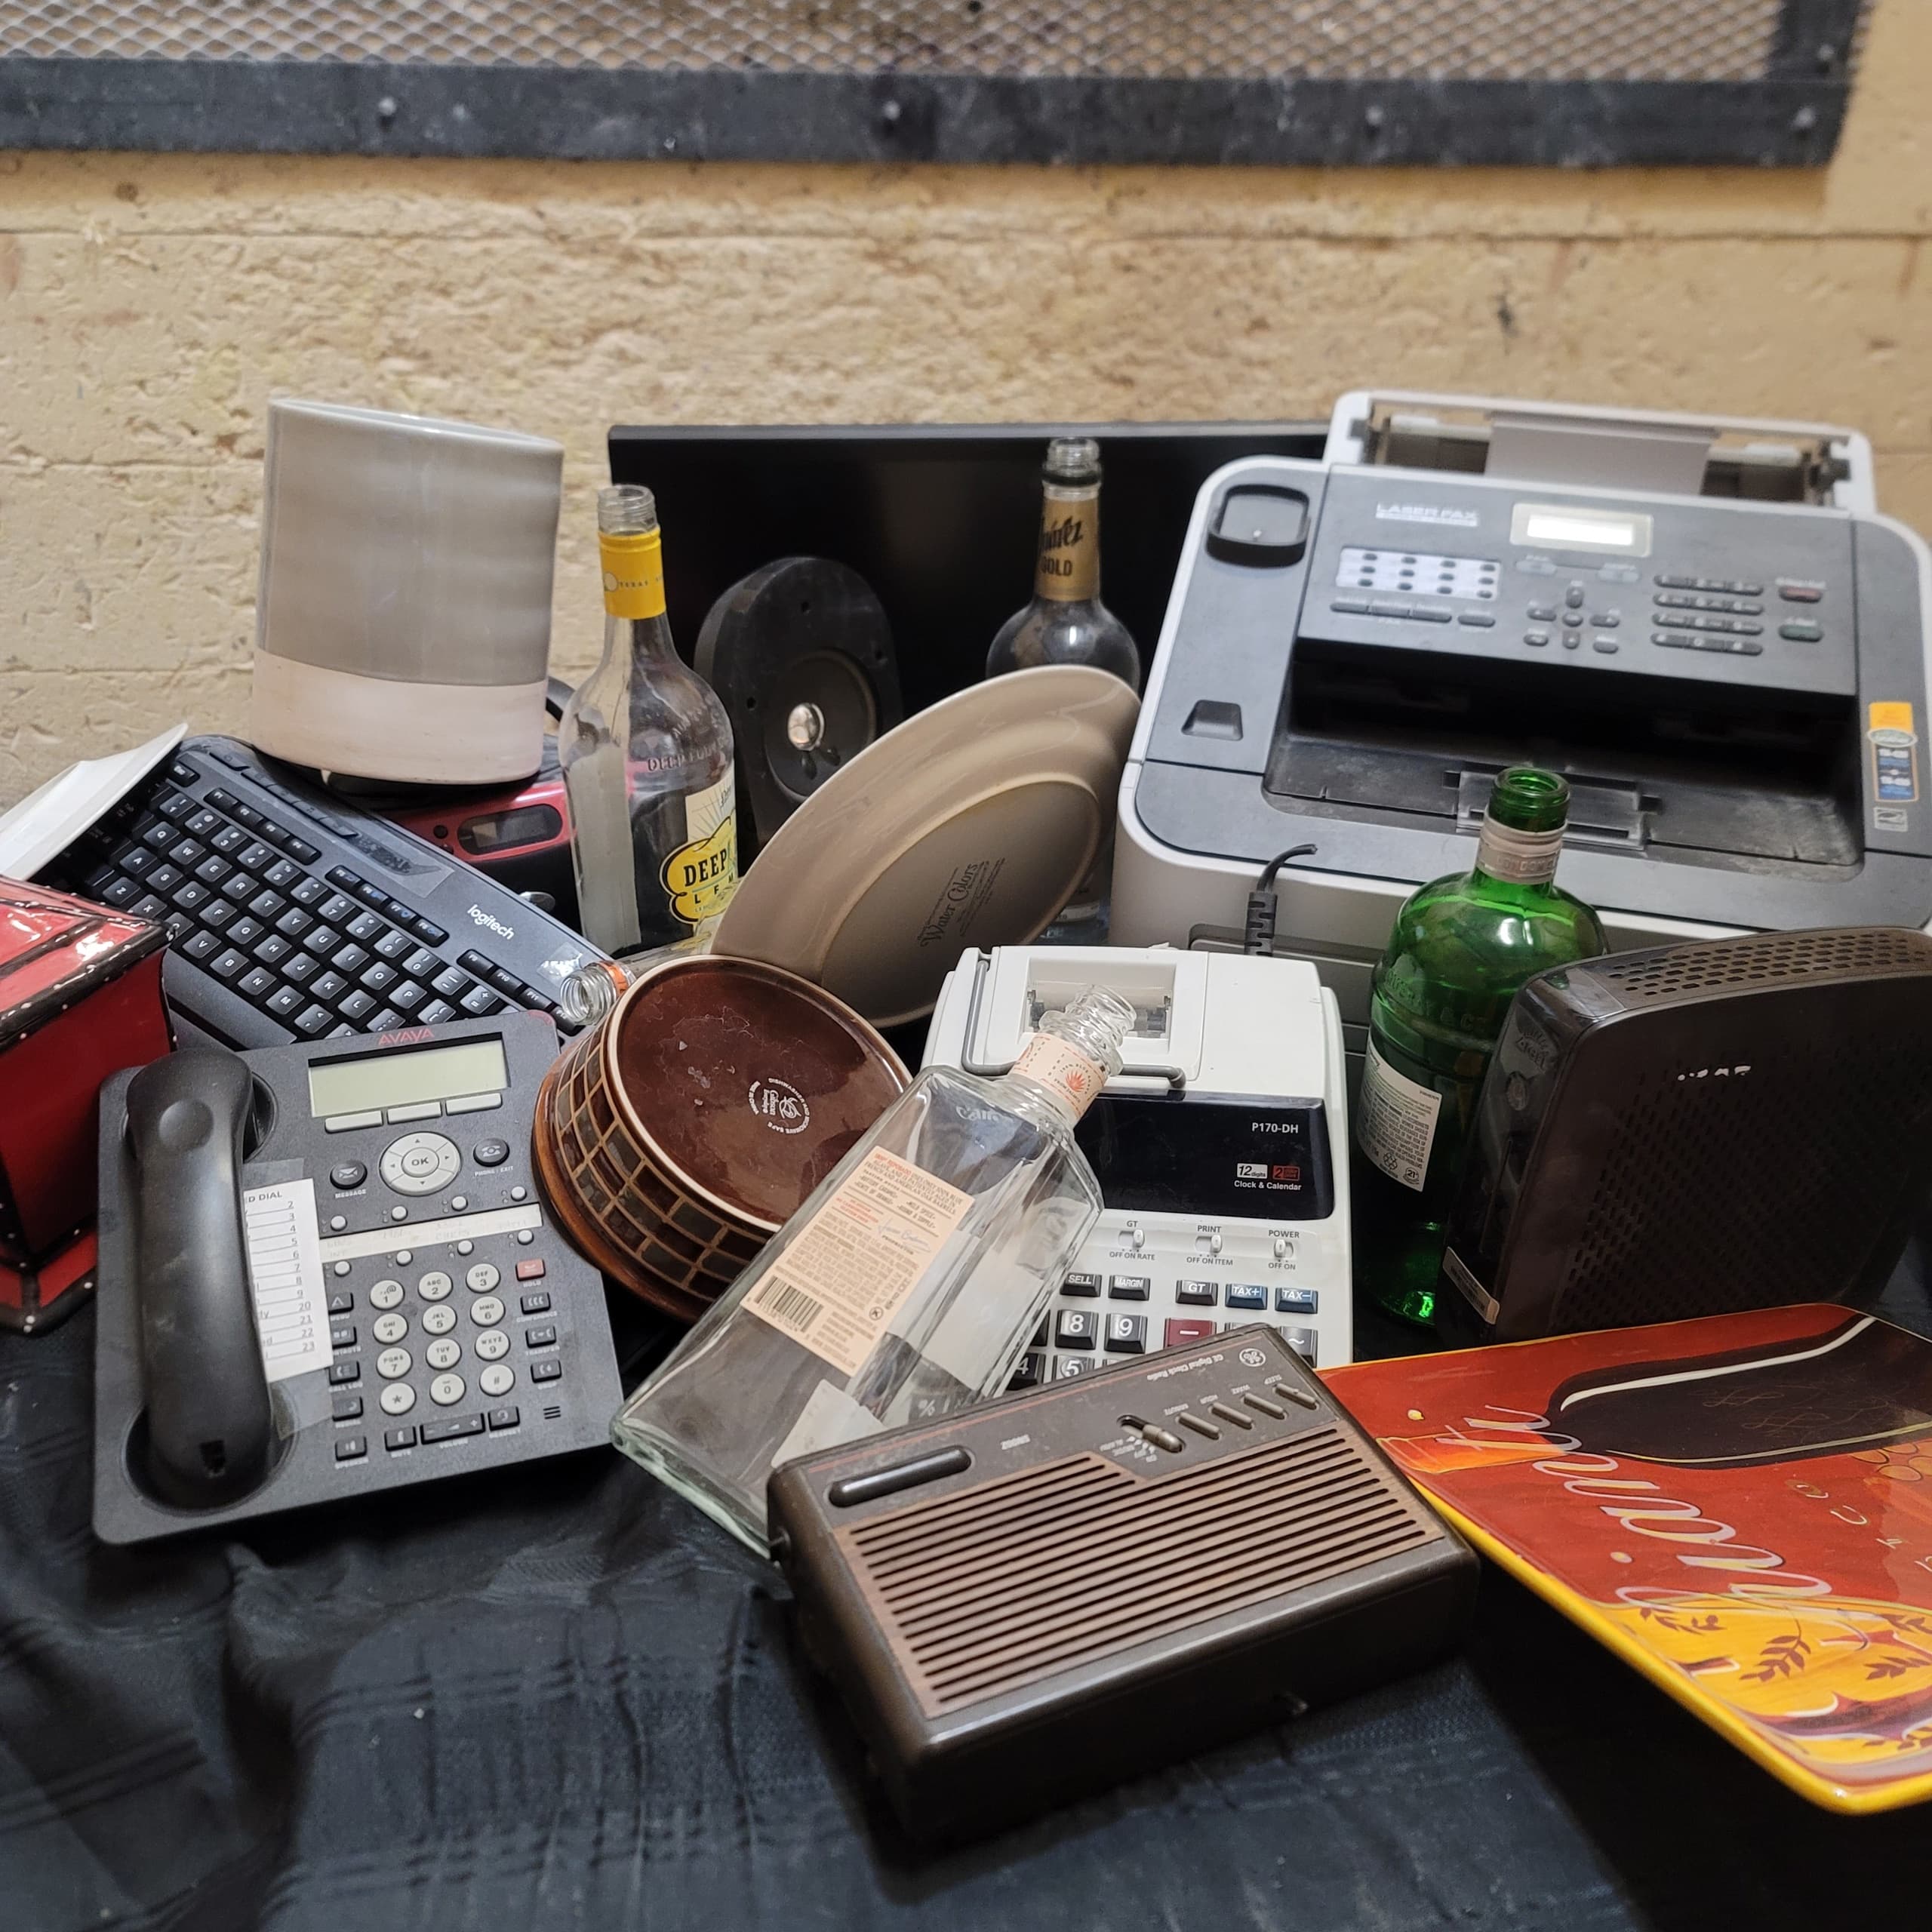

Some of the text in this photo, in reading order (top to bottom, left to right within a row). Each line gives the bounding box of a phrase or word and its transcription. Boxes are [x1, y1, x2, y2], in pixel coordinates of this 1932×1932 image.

[134, 857, 143, 865] A
[684, 848, 728, 887] DEEP
[236, 882, 245, 891] R
[921, 904, 955, 947] Water
[947, 863, 978, 901] Colors
[467, 904, 515, 941] logitech
[253, 977, 263, 986] N
[324, 982, 334, 990] K
[281, 996, 291, 1004] M
[378, 1028, 435, 1045] AVAYA
[768, 1078, 805, 1103] DISHWASHER
[770, 1090, 780, 1116] Gibson
[1251, 1122, 1299, 1134] P170-DH
[411, 1156, 429, 1167] OK
[500, 1165, 515, 1174] EXIT
[1238, 1165, 1253, 1176] 12
[1234, 1180, 1257, 1189] Clock
[1266, 1182, 1301, 1191] Calendar
[258, 1191, 283, 1201] DIAL
[334, 1189, 367, 1199] MESSAGE
[1197, 1225, 1222, 1233] PRINT
[1269, 1229, 1300, 1238] POWER
[293, 1251, 300, 1259] 6
[1137, 1253, 1155, 1261] RATE
[1215, 1258, 1233, 1266] ITEM
[294, 1263, 300, 1272] 7
[296, 1276, 302, 1284] 8
[1068, 1274, 1092, 1284] SELL
[1115, 1278, 1143, 1287] MARGIN
[1188, 1283, 1206, 1293] GT
[1233, 1286, 1260, 1297] TAX+
[383, 1295, 389, 1303] 1
[299, 1301, 311, 1311] 20
[300, 1314, 312, 1324] 21
[1069, 1314, 1084, 1333] 8
[1118, 1317, 1134, 1337] 9
[301, 1328, 314, 1338] 22
[386, 1328, 393, 1337] 4
[303, 1342, 315, 1352] 23
[489, 1346, 497, 1354] 9
[391, 1364, 398, 1372] 7
[1018, 1357, 1029, 1374] 4
[1190, 1357, 1212, 1369] Digital
[1063, 1360, 1080, 1377] 5
[1168, 1364, 1189, 1375] Clock
